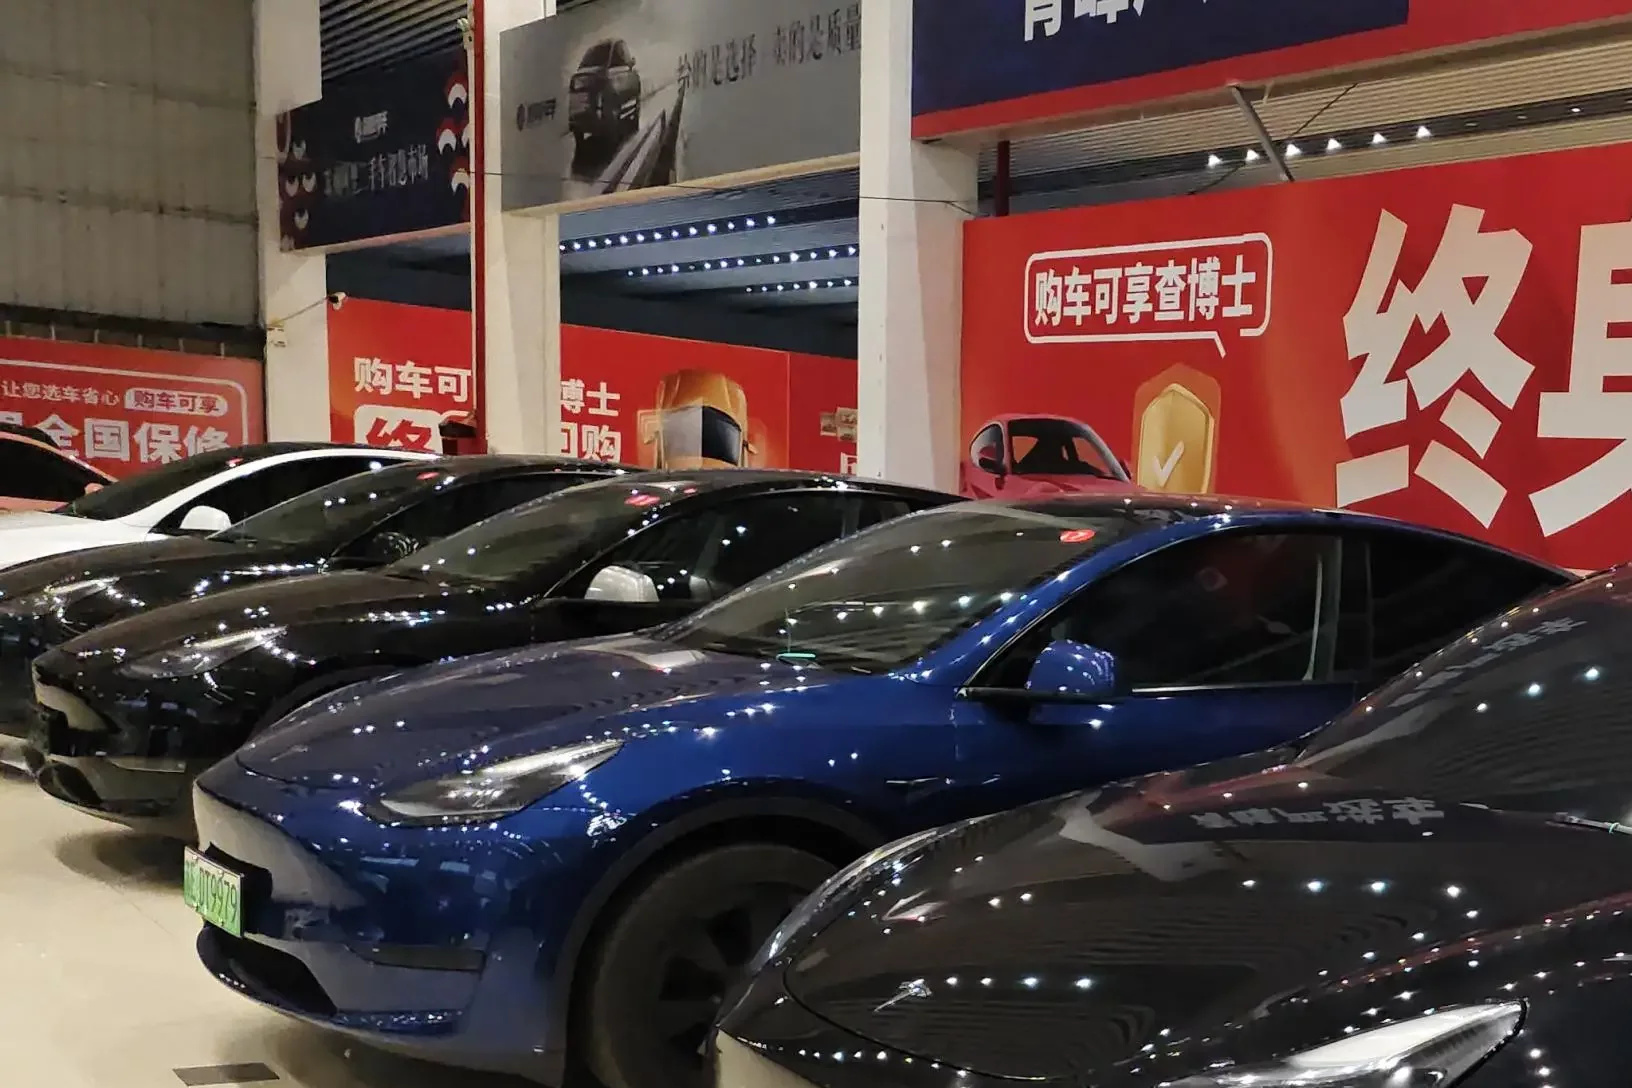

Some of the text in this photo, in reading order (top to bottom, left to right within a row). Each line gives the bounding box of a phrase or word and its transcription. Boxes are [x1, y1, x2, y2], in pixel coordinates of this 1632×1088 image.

[1035, 254, 1257, 327] 购车可享查博士
[1, 379, 120, 406] 让您选车省心
[353, 356, 472, 402] 购车可
[133, 390, 220, 414] 购车可享
